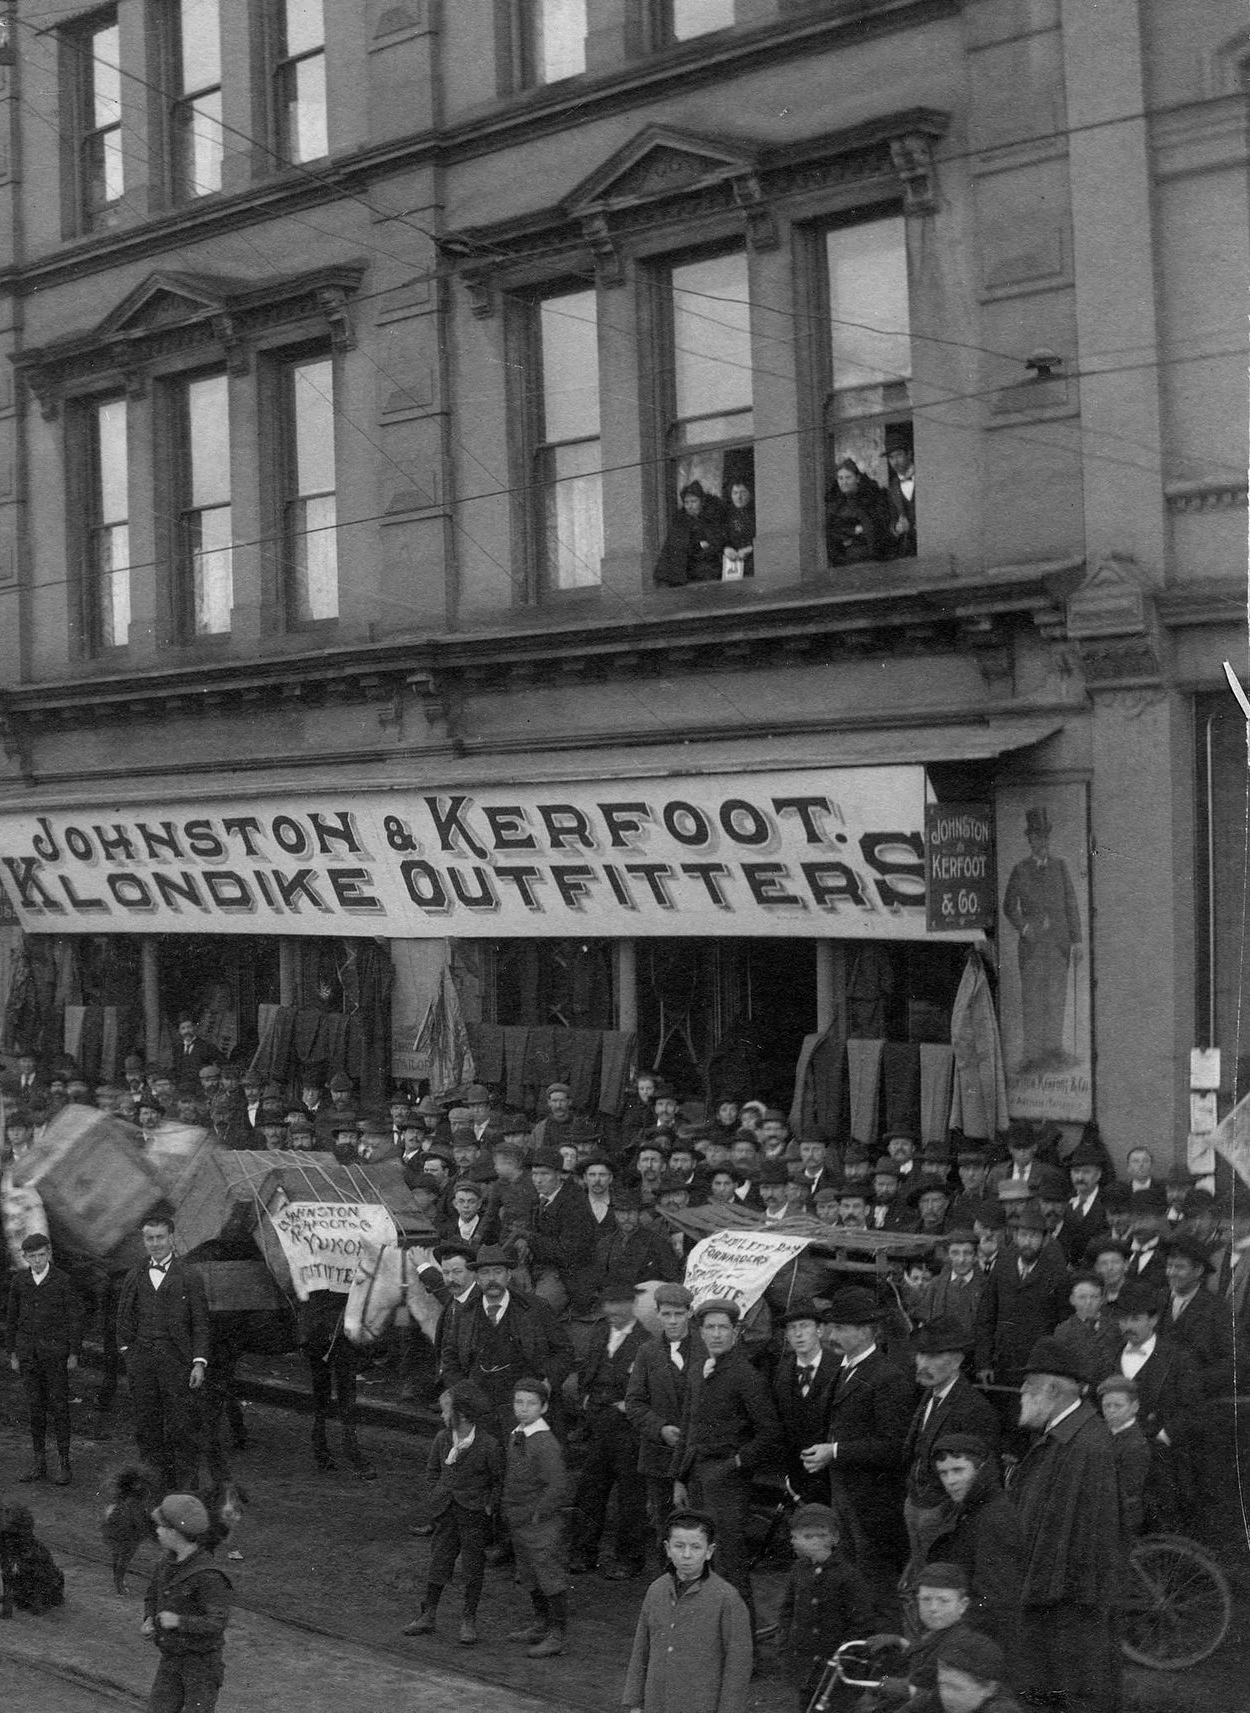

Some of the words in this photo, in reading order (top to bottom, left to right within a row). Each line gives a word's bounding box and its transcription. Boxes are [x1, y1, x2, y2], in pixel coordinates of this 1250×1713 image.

[32, 811, 366, 863] JOHNSTON
[384, 814, 418, 853] &
[931, 816, 989, 845] JOHNSTON
[2, 856, 385, 913] KLONDIKE
[399, 832, 926, 914] OUTFITTERS
[932, 854, 987, 879] KERFOOT
[941, 892, 956, 915] &
